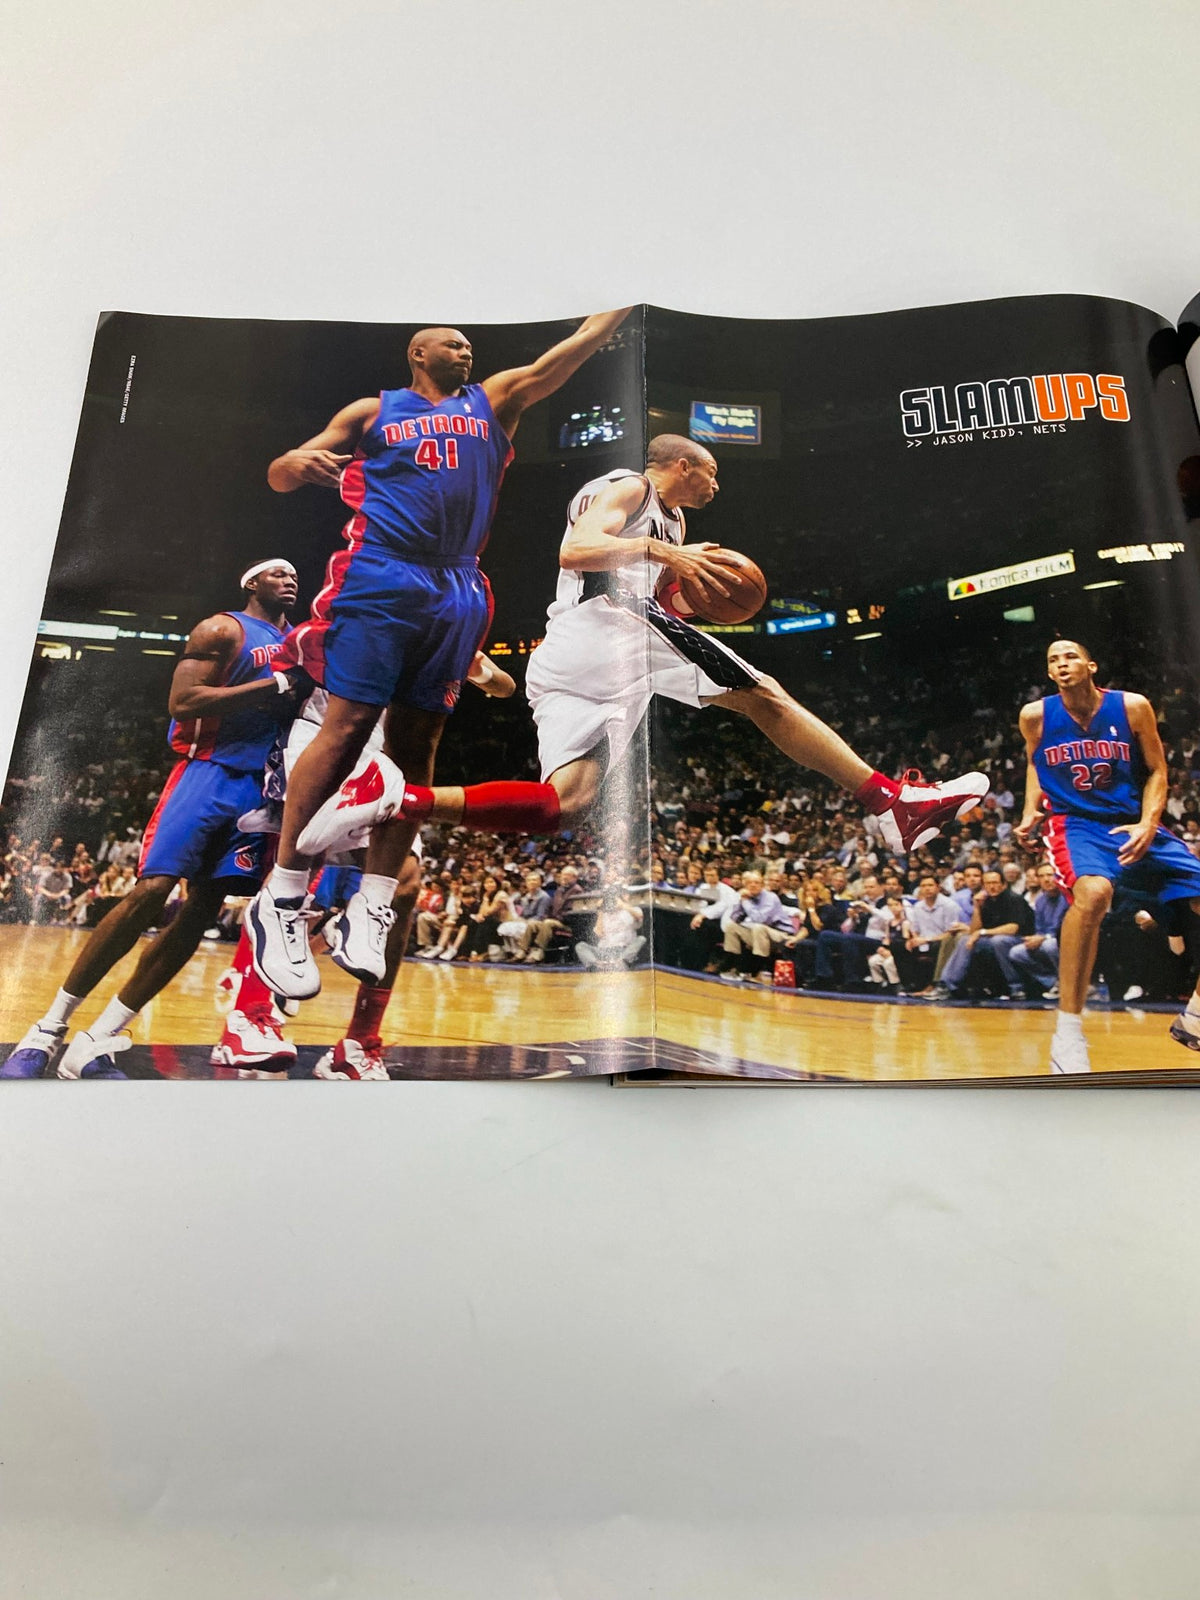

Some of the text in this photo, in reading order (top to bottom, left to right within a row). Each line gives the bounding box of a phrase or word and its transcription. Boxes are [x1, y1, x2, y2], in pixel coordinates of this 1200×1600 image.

[381, 414, 489, 446] DETROIT
[933, 432, 974, 446] JASON
[982, 427, 1024, 440] KIDD,
[1033, 423, 1067, 435] NETS
[415, 438, 459, 471] 41
[1034, 559, 1072, 576] FILM
[1044, 739, 1131, 766] DETROIT
[1070, 762, 1113, 791] 22
